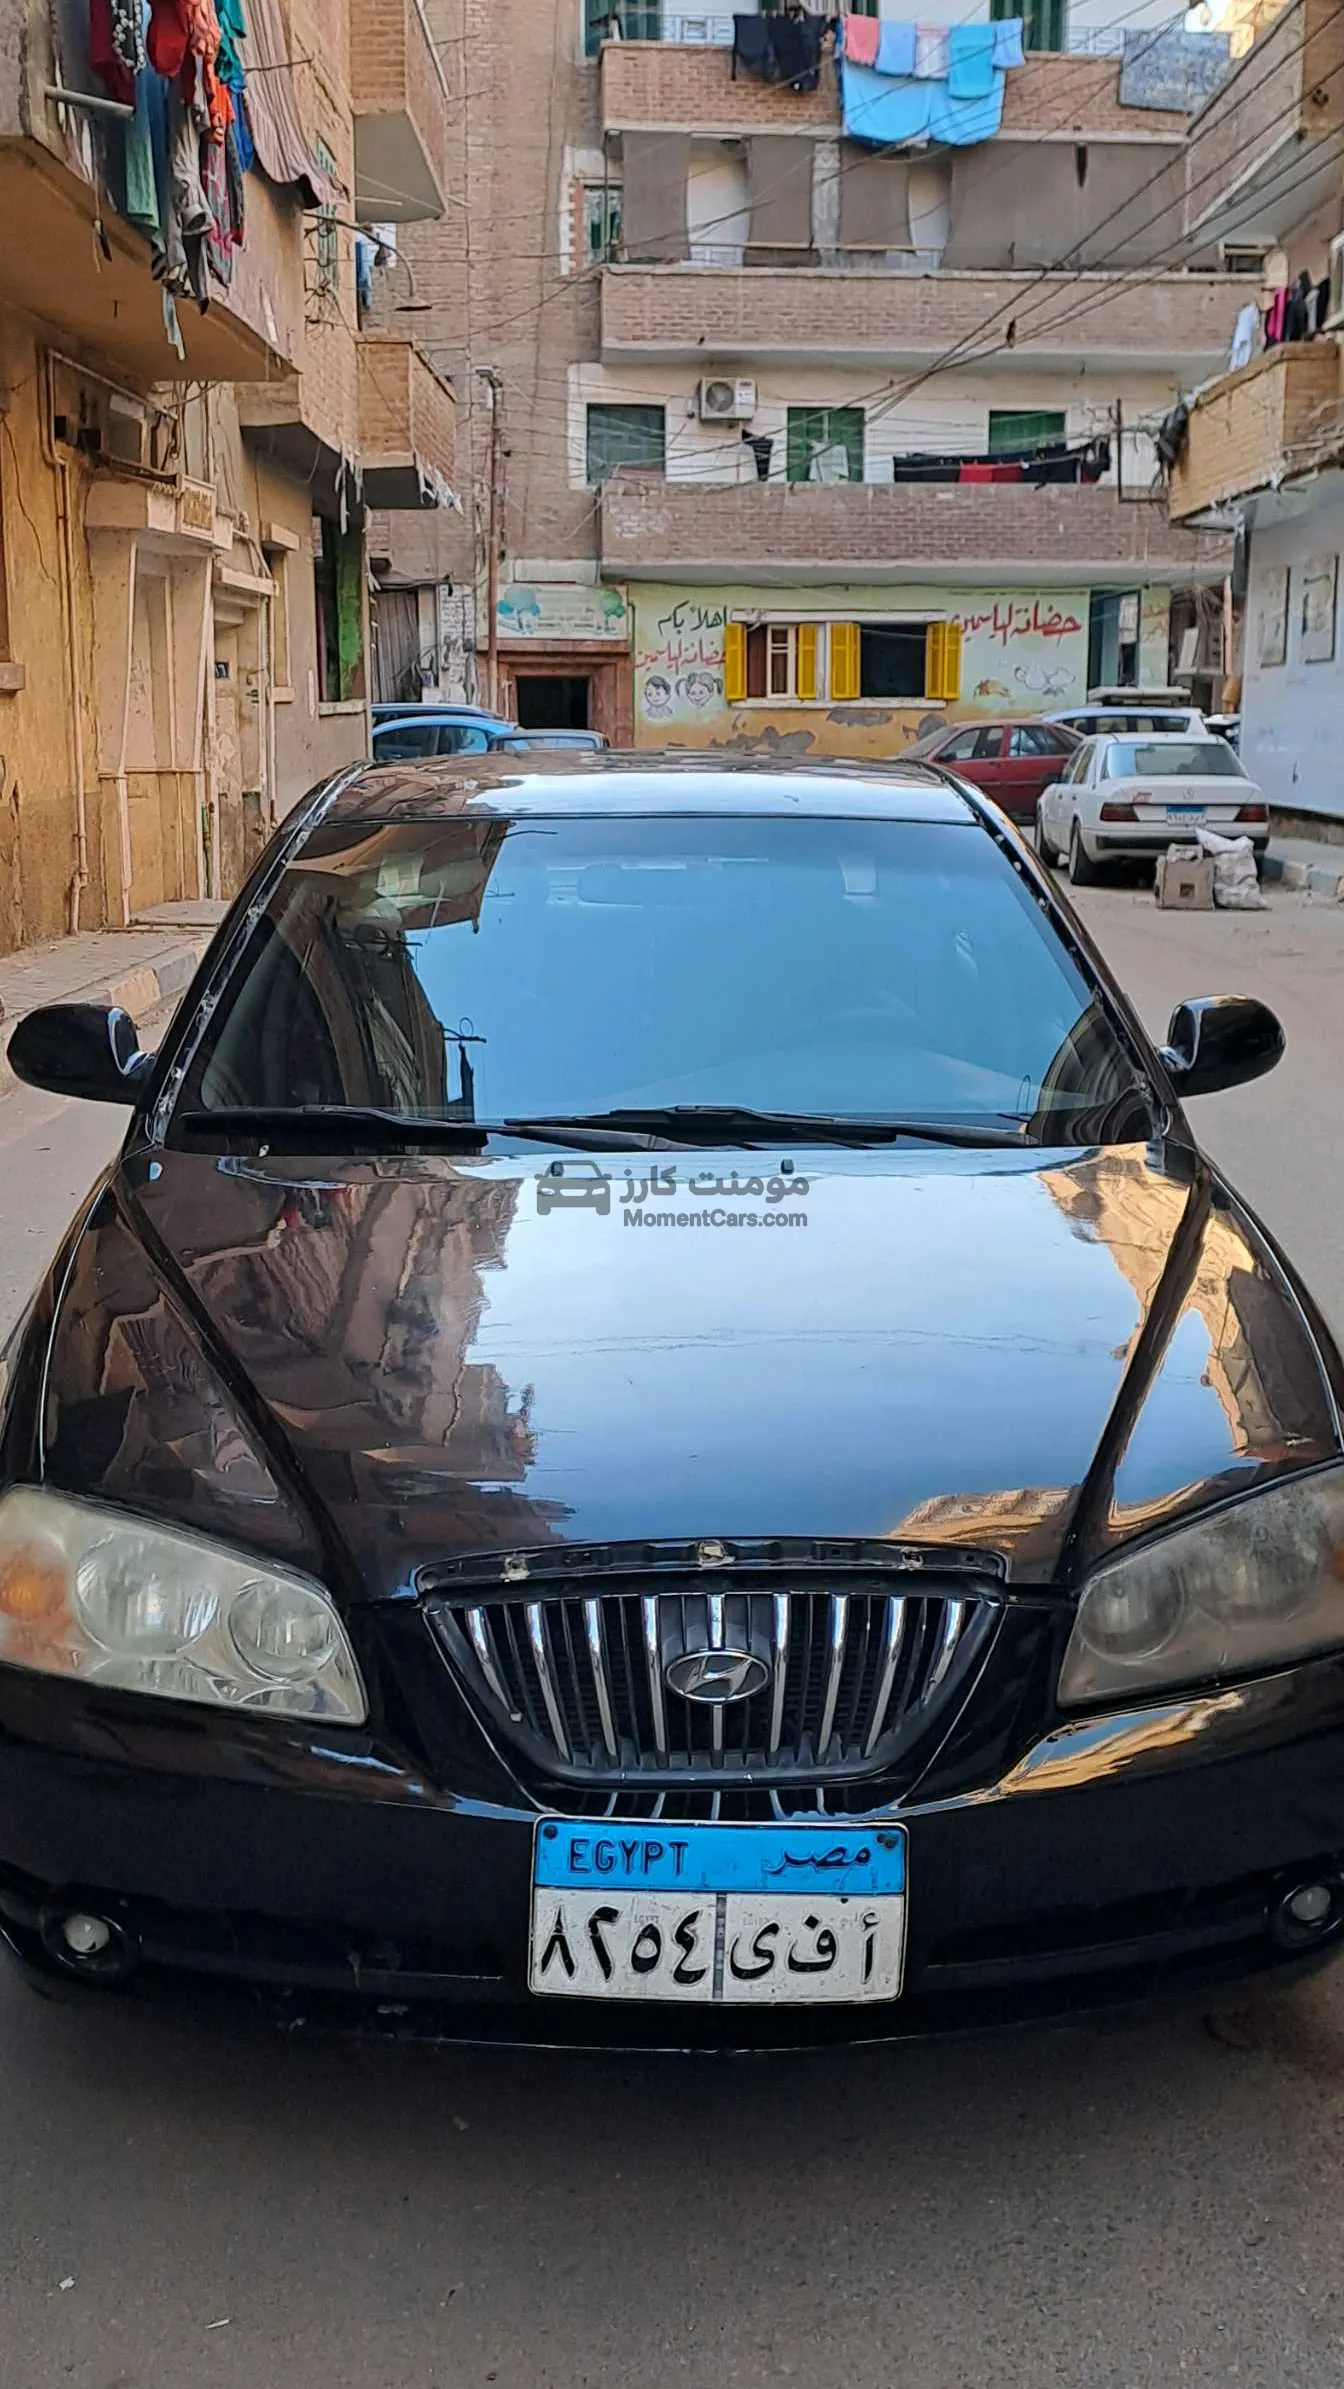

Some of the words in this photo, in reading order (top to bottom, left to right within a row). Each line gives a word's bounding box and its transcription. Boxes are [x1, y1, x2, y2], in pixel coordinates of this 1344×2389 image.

[658, 600, 690, 636] بكم
[1010, 600, 1082, 648] حضانة
[569, 1838, 689, 1875] EGYPT
[766, 1842, 872, 1875] مصر
